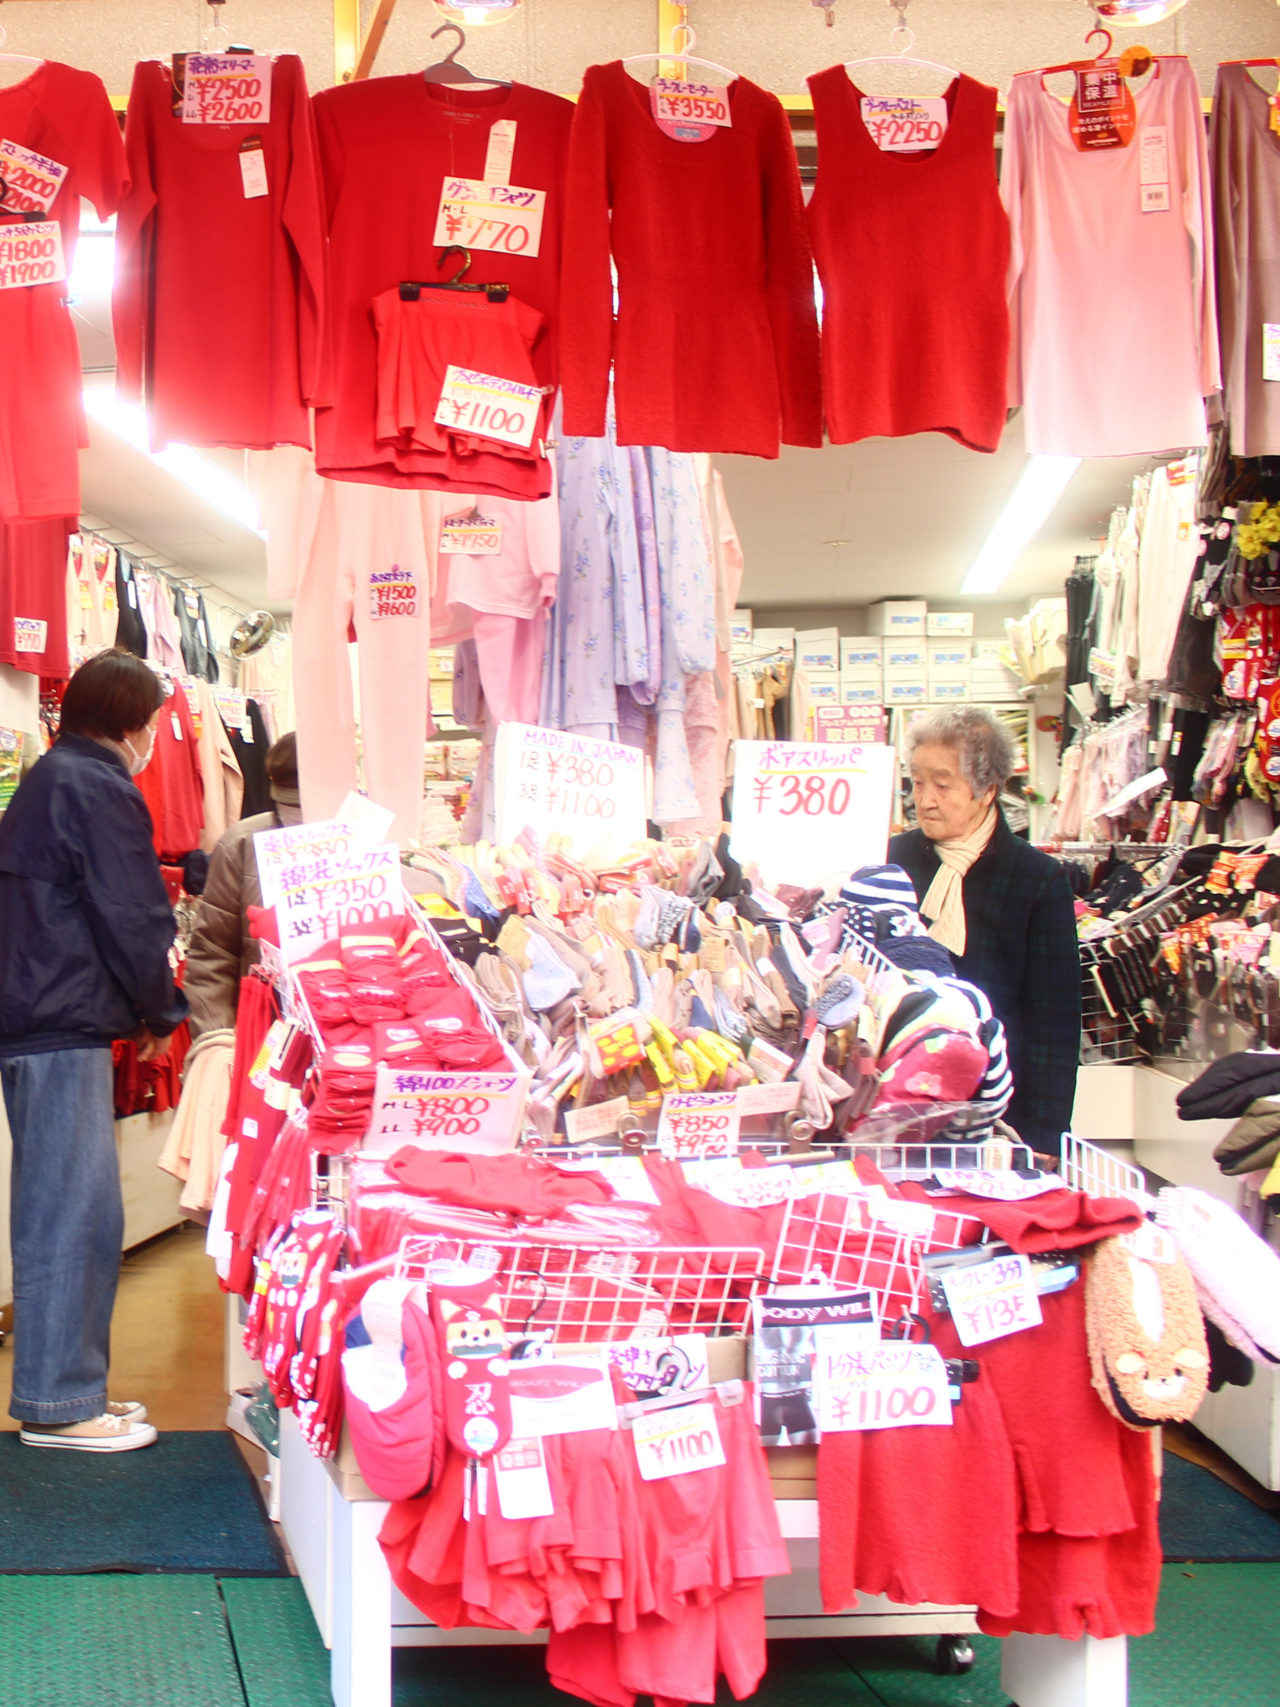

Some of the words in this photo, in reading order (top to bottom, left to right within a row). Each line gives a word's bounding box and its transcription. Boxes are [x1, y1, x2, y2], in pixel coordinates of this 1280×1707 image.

[197, 78, 261, 102] ¥2500
[1085, 72, 1118, 86] 集中
[1085, 86, 1119, 100] 保温
[198, 101, 262, 123] ¥2600
[665, 97, 726, 120] ¥3550
[871, 119, 943, 148] ¥2250
[0, 160, 56, 200] ¥2000
[445, 213, 530, 253] ¥770
[450, 400, 526, 434] ¥1100
[523, 730, 565, 748] MADE
[571, 738, 587, 754] IN
[592, 743, 641, 765] JAPAN
[826, 727, 876, 742] 取扱店
[546, 751, 614, 787] ¥380
[759, 743, 863, 769] ボアスリッパ
[545, 785, 617, 819] ¥1100
[753, 774, 851, 816] ¥380
[312, 874, 387, 910] ¥350
[316, 900, 394, 940] ¥1000
[415, 1096, 490, 1118] ¥800
[410, 1117, 481, 1137] ¥900
[669, 1114, 730, 1133] ¥850
[674, 1132, 729, 1155] ¥950
[465, 1383, 495, 1415] 忍
[831, 1385, 937, 1427] ¥1100
[647, 1429, 715, 1472] ¥1100
